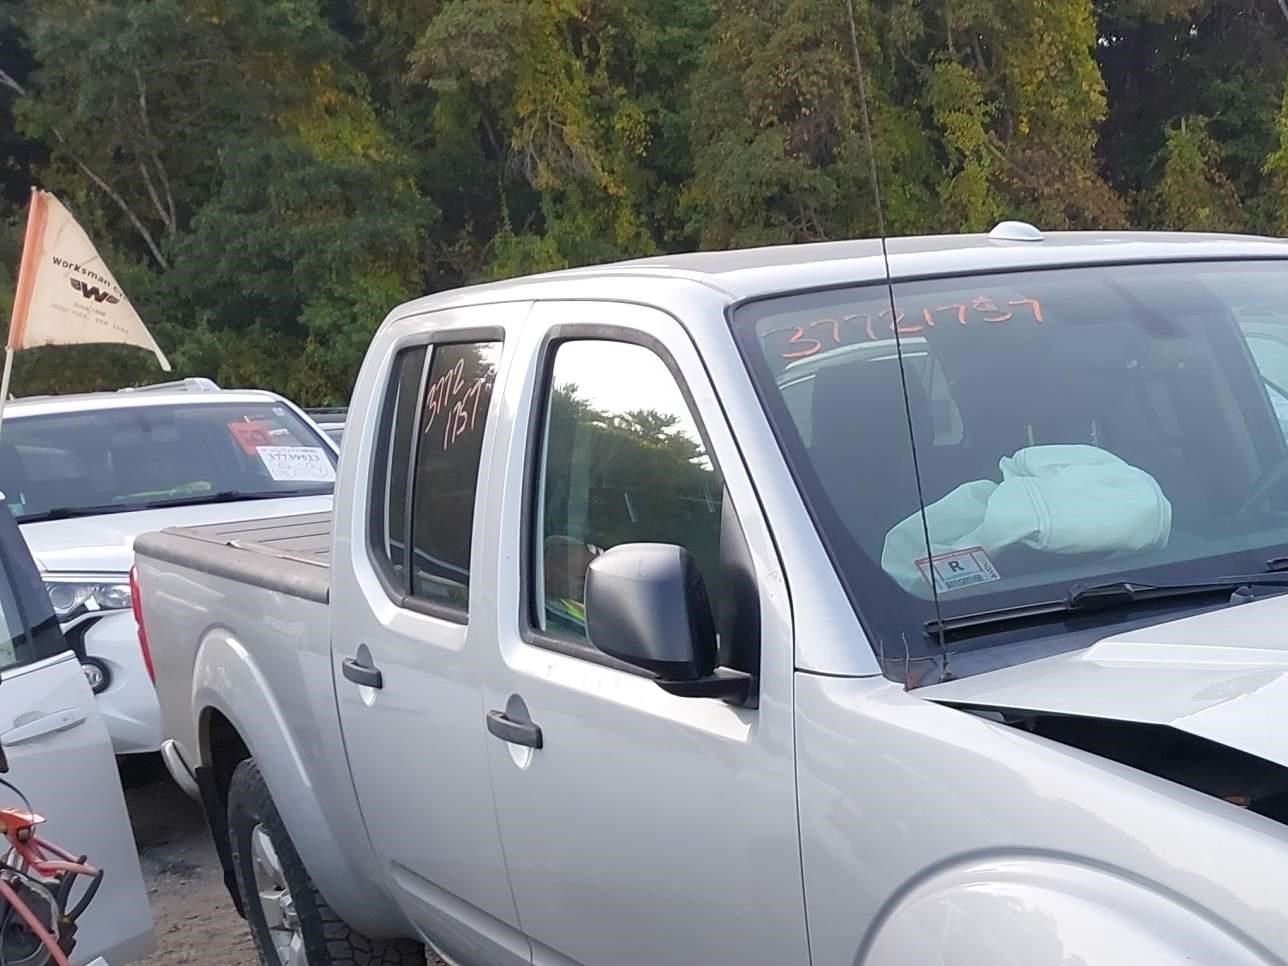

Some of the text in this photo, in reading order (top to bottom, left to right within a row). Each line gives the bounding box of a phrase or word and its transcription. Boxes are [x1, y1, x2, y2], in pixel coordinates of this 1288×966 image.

[53, 256, 111, 287] Worksman
[761, 296, 1043, 358] 37721757
[424, 357, 465, 434] 3772
[948, 560, 965, 573] R
